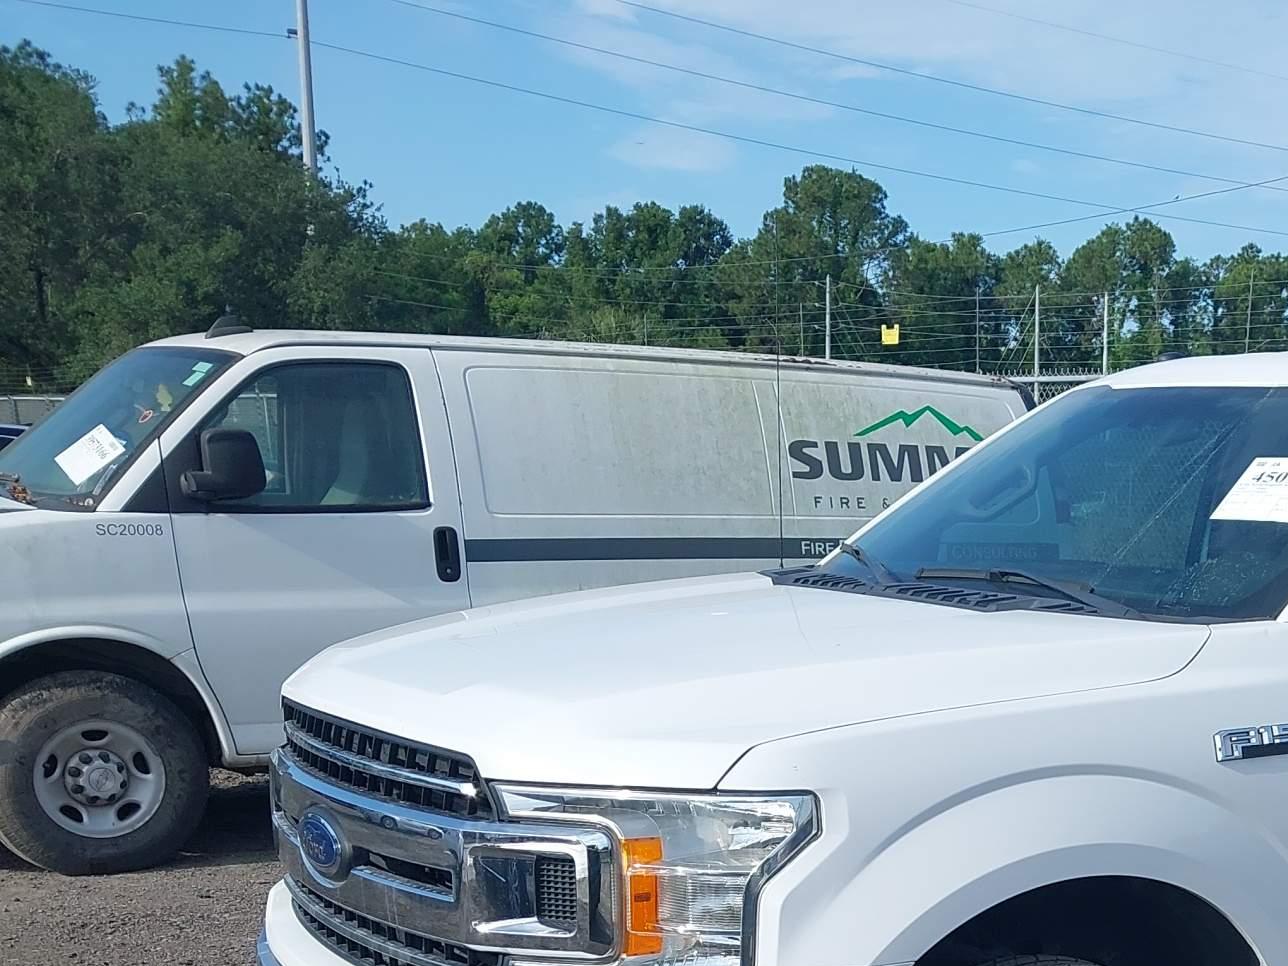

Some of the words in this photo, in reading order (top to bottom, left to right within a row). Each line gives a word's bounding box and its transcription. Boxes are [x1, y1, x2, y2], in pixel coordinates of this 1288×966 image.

[814, 496, 866, 509] FIRE
[95, 523, 164, 536] SC20008
[801, 541, 835, 555] FIRE
